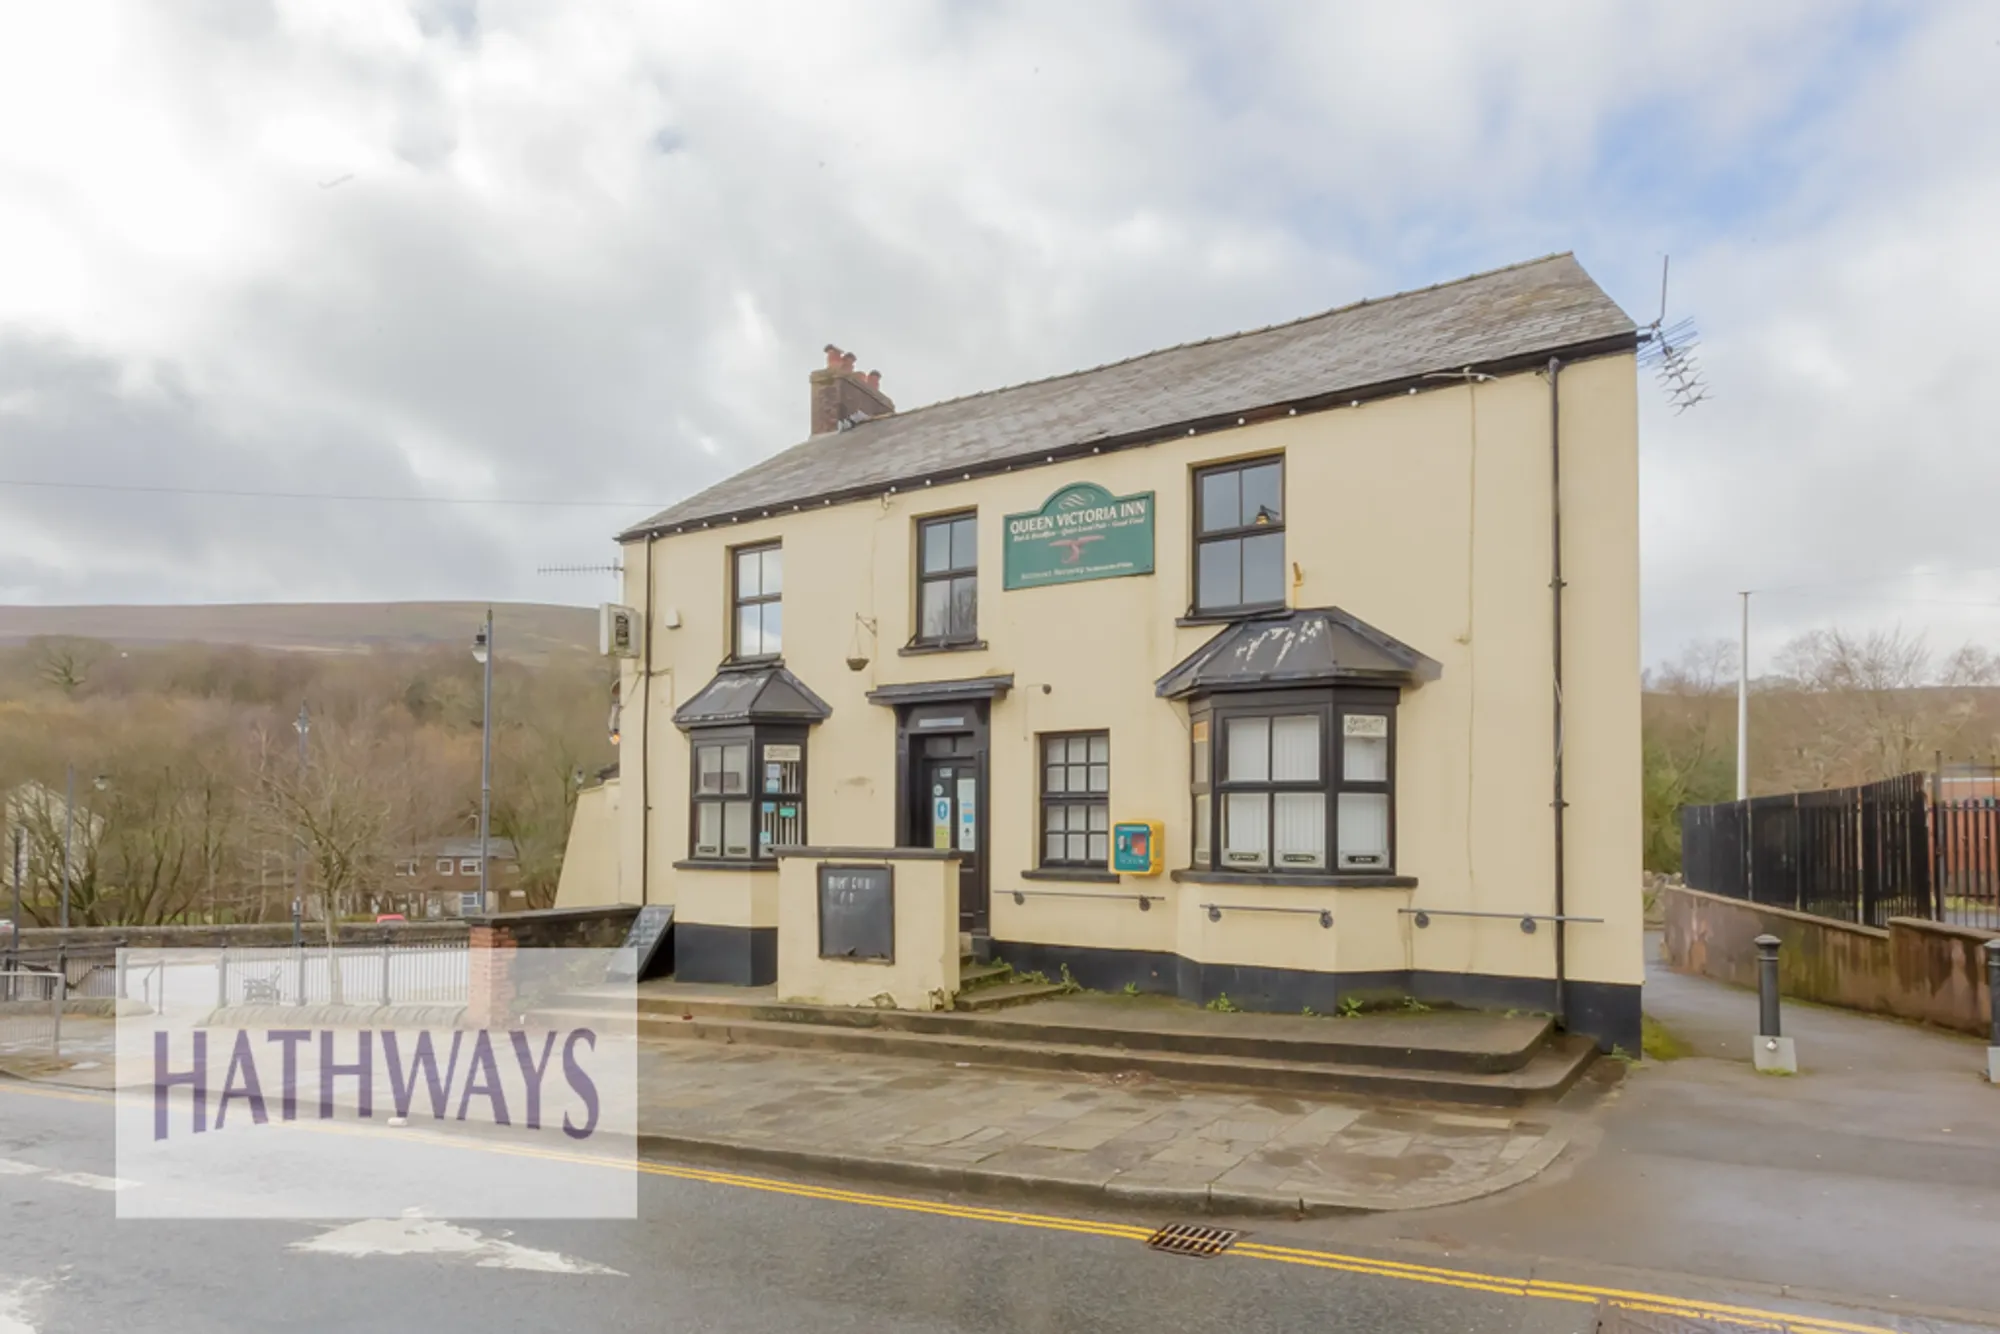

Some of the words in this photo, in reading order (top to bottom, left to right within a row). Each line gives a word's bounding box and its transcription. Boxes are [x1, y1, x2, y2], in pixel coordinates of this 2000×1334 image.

[1010, 516, 1053, 534] QUEEN
[1057, 505, 1117, 527] VICTORIA
[1121, 500, 1145, 517] INN
